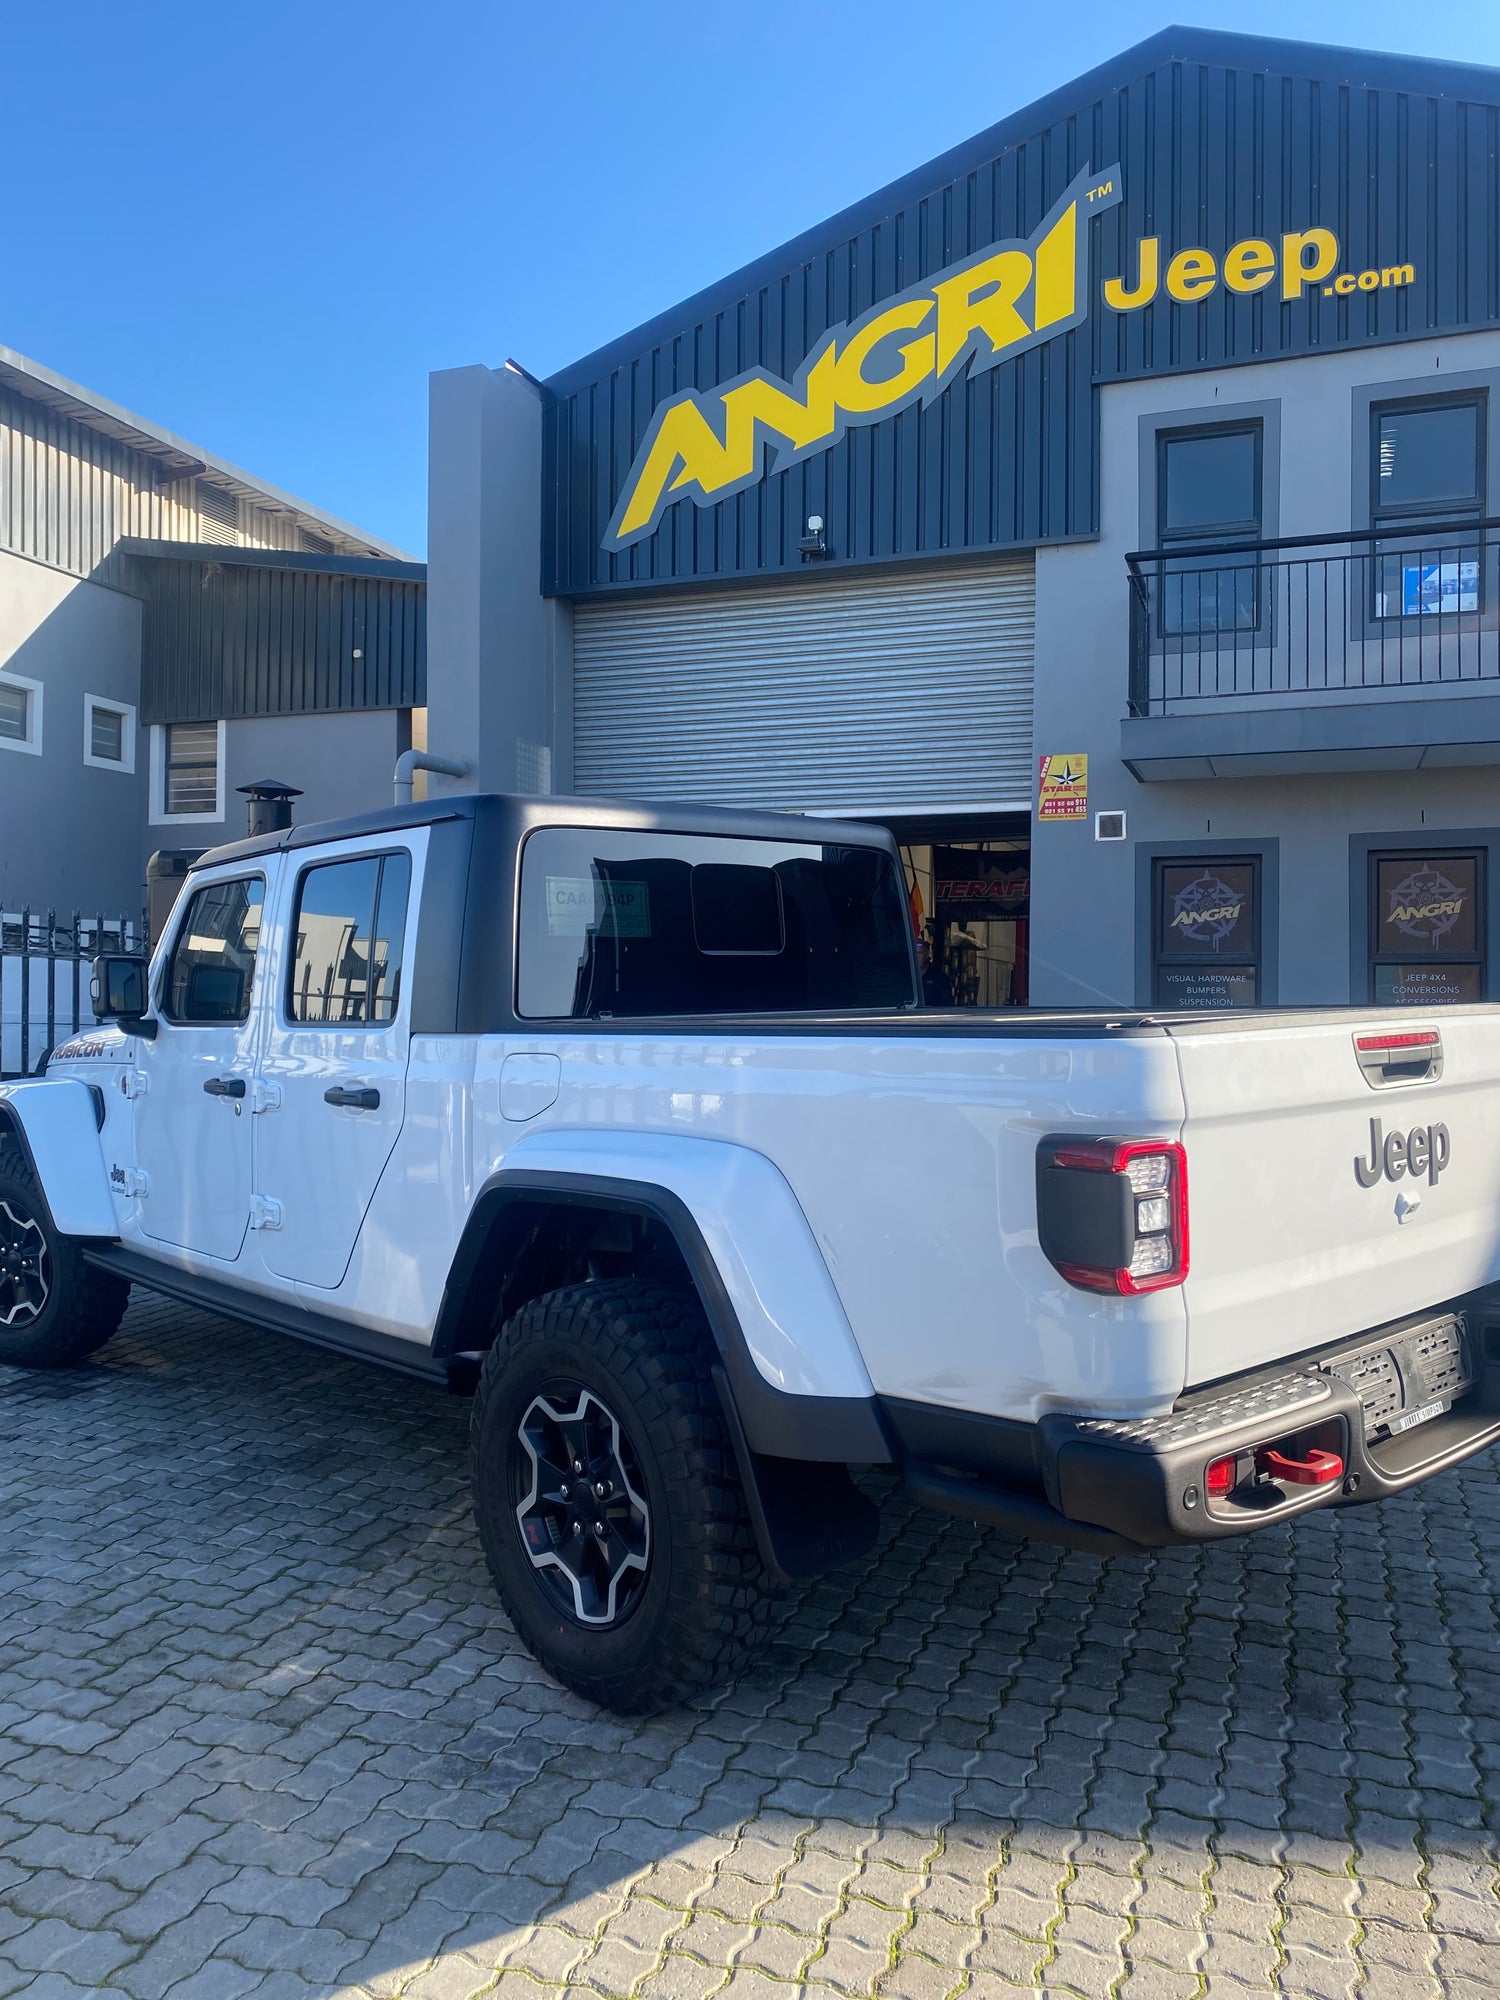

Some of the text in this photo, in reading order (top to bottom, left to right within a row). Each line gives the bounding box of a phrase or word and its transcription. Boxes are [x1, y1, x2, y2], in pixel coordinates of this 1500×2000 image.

[616, 199, 1077, 539] ANGRI
[1040, 756, 1052, 778] STAR
[1170, 903, 1241, 927] ANGRI
[1386, 899, 1463, 923] ANGRI
[1166, 975, 1247, 983] VISUAL HARDWARE
[1405, 974, 1427, 982] JEEP
[1186, 986, 1227, 994] BUMPERS
[1392, 986, 1460, 994] CONVERSIONS
[1179, 998, 1234, 1006] SUSPENSION
[51, 1041, 106, 1060] RUBICON
[1353, 1117, 1451, 1189] Jeep
[110, 1163, 125, 1184] Jee
